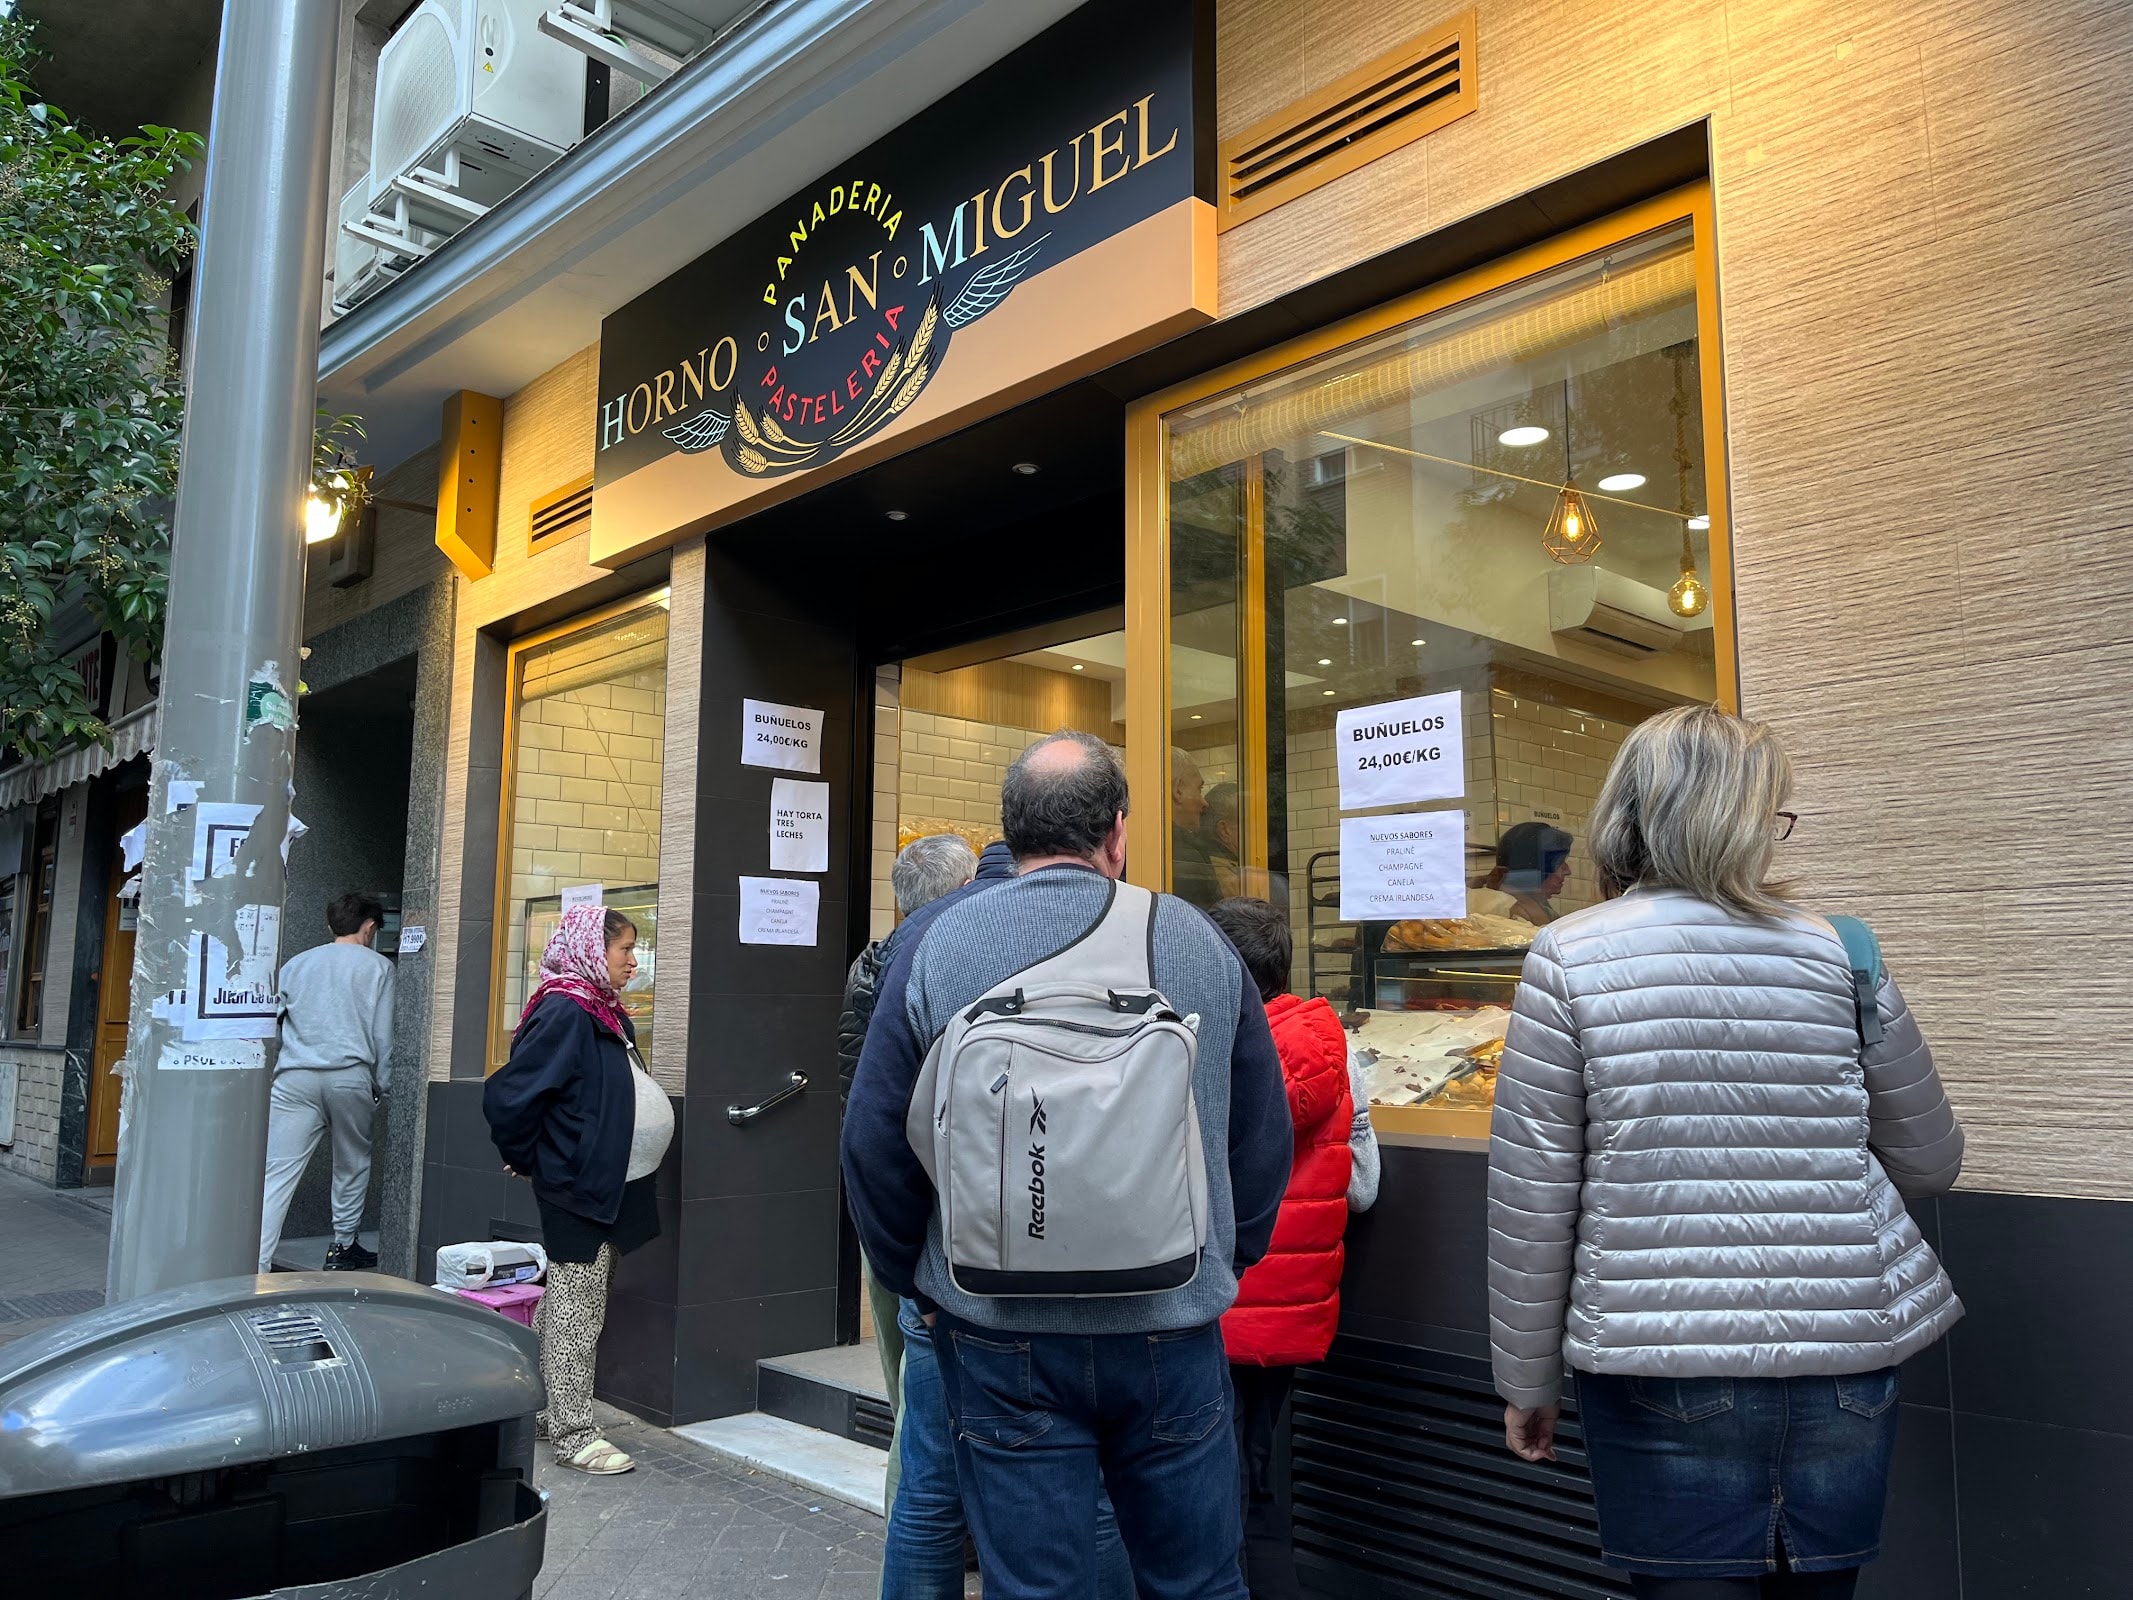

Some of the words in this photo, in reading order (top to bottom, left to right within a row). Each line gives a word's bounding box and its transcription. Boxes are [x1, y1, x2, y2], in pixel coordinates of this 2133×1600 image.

[763, 180, 903, 306] PANADERIA
[601, 336, 740, 451] HORNO
[782, 250, 880, 358] SAN
[917, 92, 1180, 287] MIGUEL
[761, 304, 905, 426] PASTELERIA
[754, 713, 812, 731] BUÑUELOS
[1352, 715, 1446, 742] BUÑUELOS
[756, 732, 809, 749] 24,00€/KG
[1357, 746, 1442, 771] 24,00€/KG
[776, 809, 794, 819] HAY
[796, 810, 823, 821] TORTA
[776, 818, 795, 828] TRES
[776, 830, 804, 840] LECHES
[1369, 831, 1399, 841] NUEVOS
[1400, 830, 1433, 840] SABORES
[1378, 862, 1424, 872] CHAMPAGNE
[1387, 878, 1415, 887] CANELA
[1369, 894, 1394, 903] CREMA
[1395, 893, 1435, 902] IRLANDESA
[1027, 1141, 1045, 1240] Reebok
